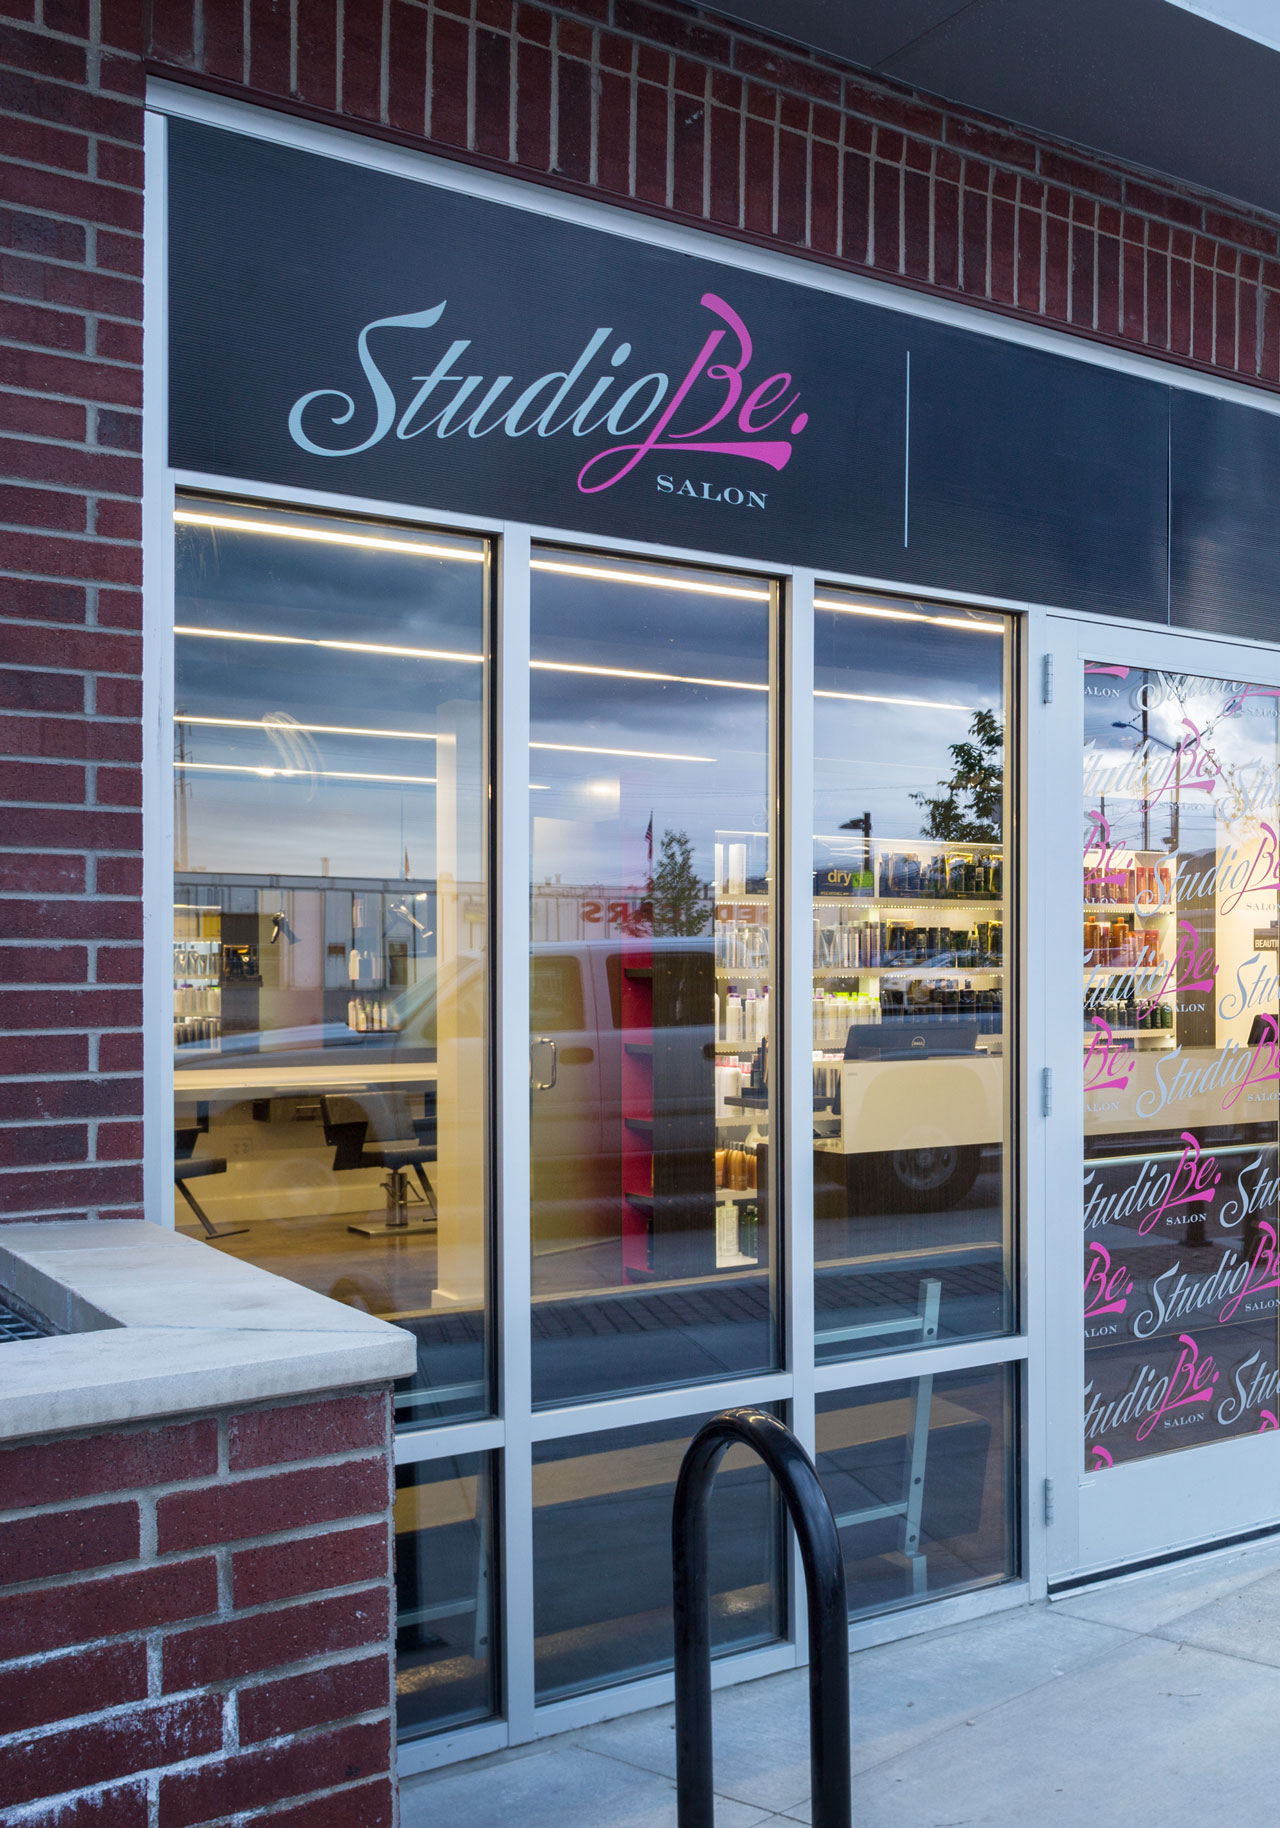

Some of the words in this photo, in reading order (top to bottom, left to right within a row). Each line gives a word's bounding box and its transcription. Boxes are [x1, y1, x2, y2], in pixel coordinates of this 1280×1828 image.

[656, 474, 768, 509] SALON
[1084, 686, 1121, 698] ALON
[827, 869, 852, 886] dry
[1083, 897, 1119, 906] ALON
[1164, 1003, 1206, 1013] SALON
[1083, 1102, 1120, 1113] ALON
[1166, 1213, 1207, 1226] SALON
[1083, 1324, 1118, 1338] ALON
[1164, 1412, 1205, 1430] SALON
